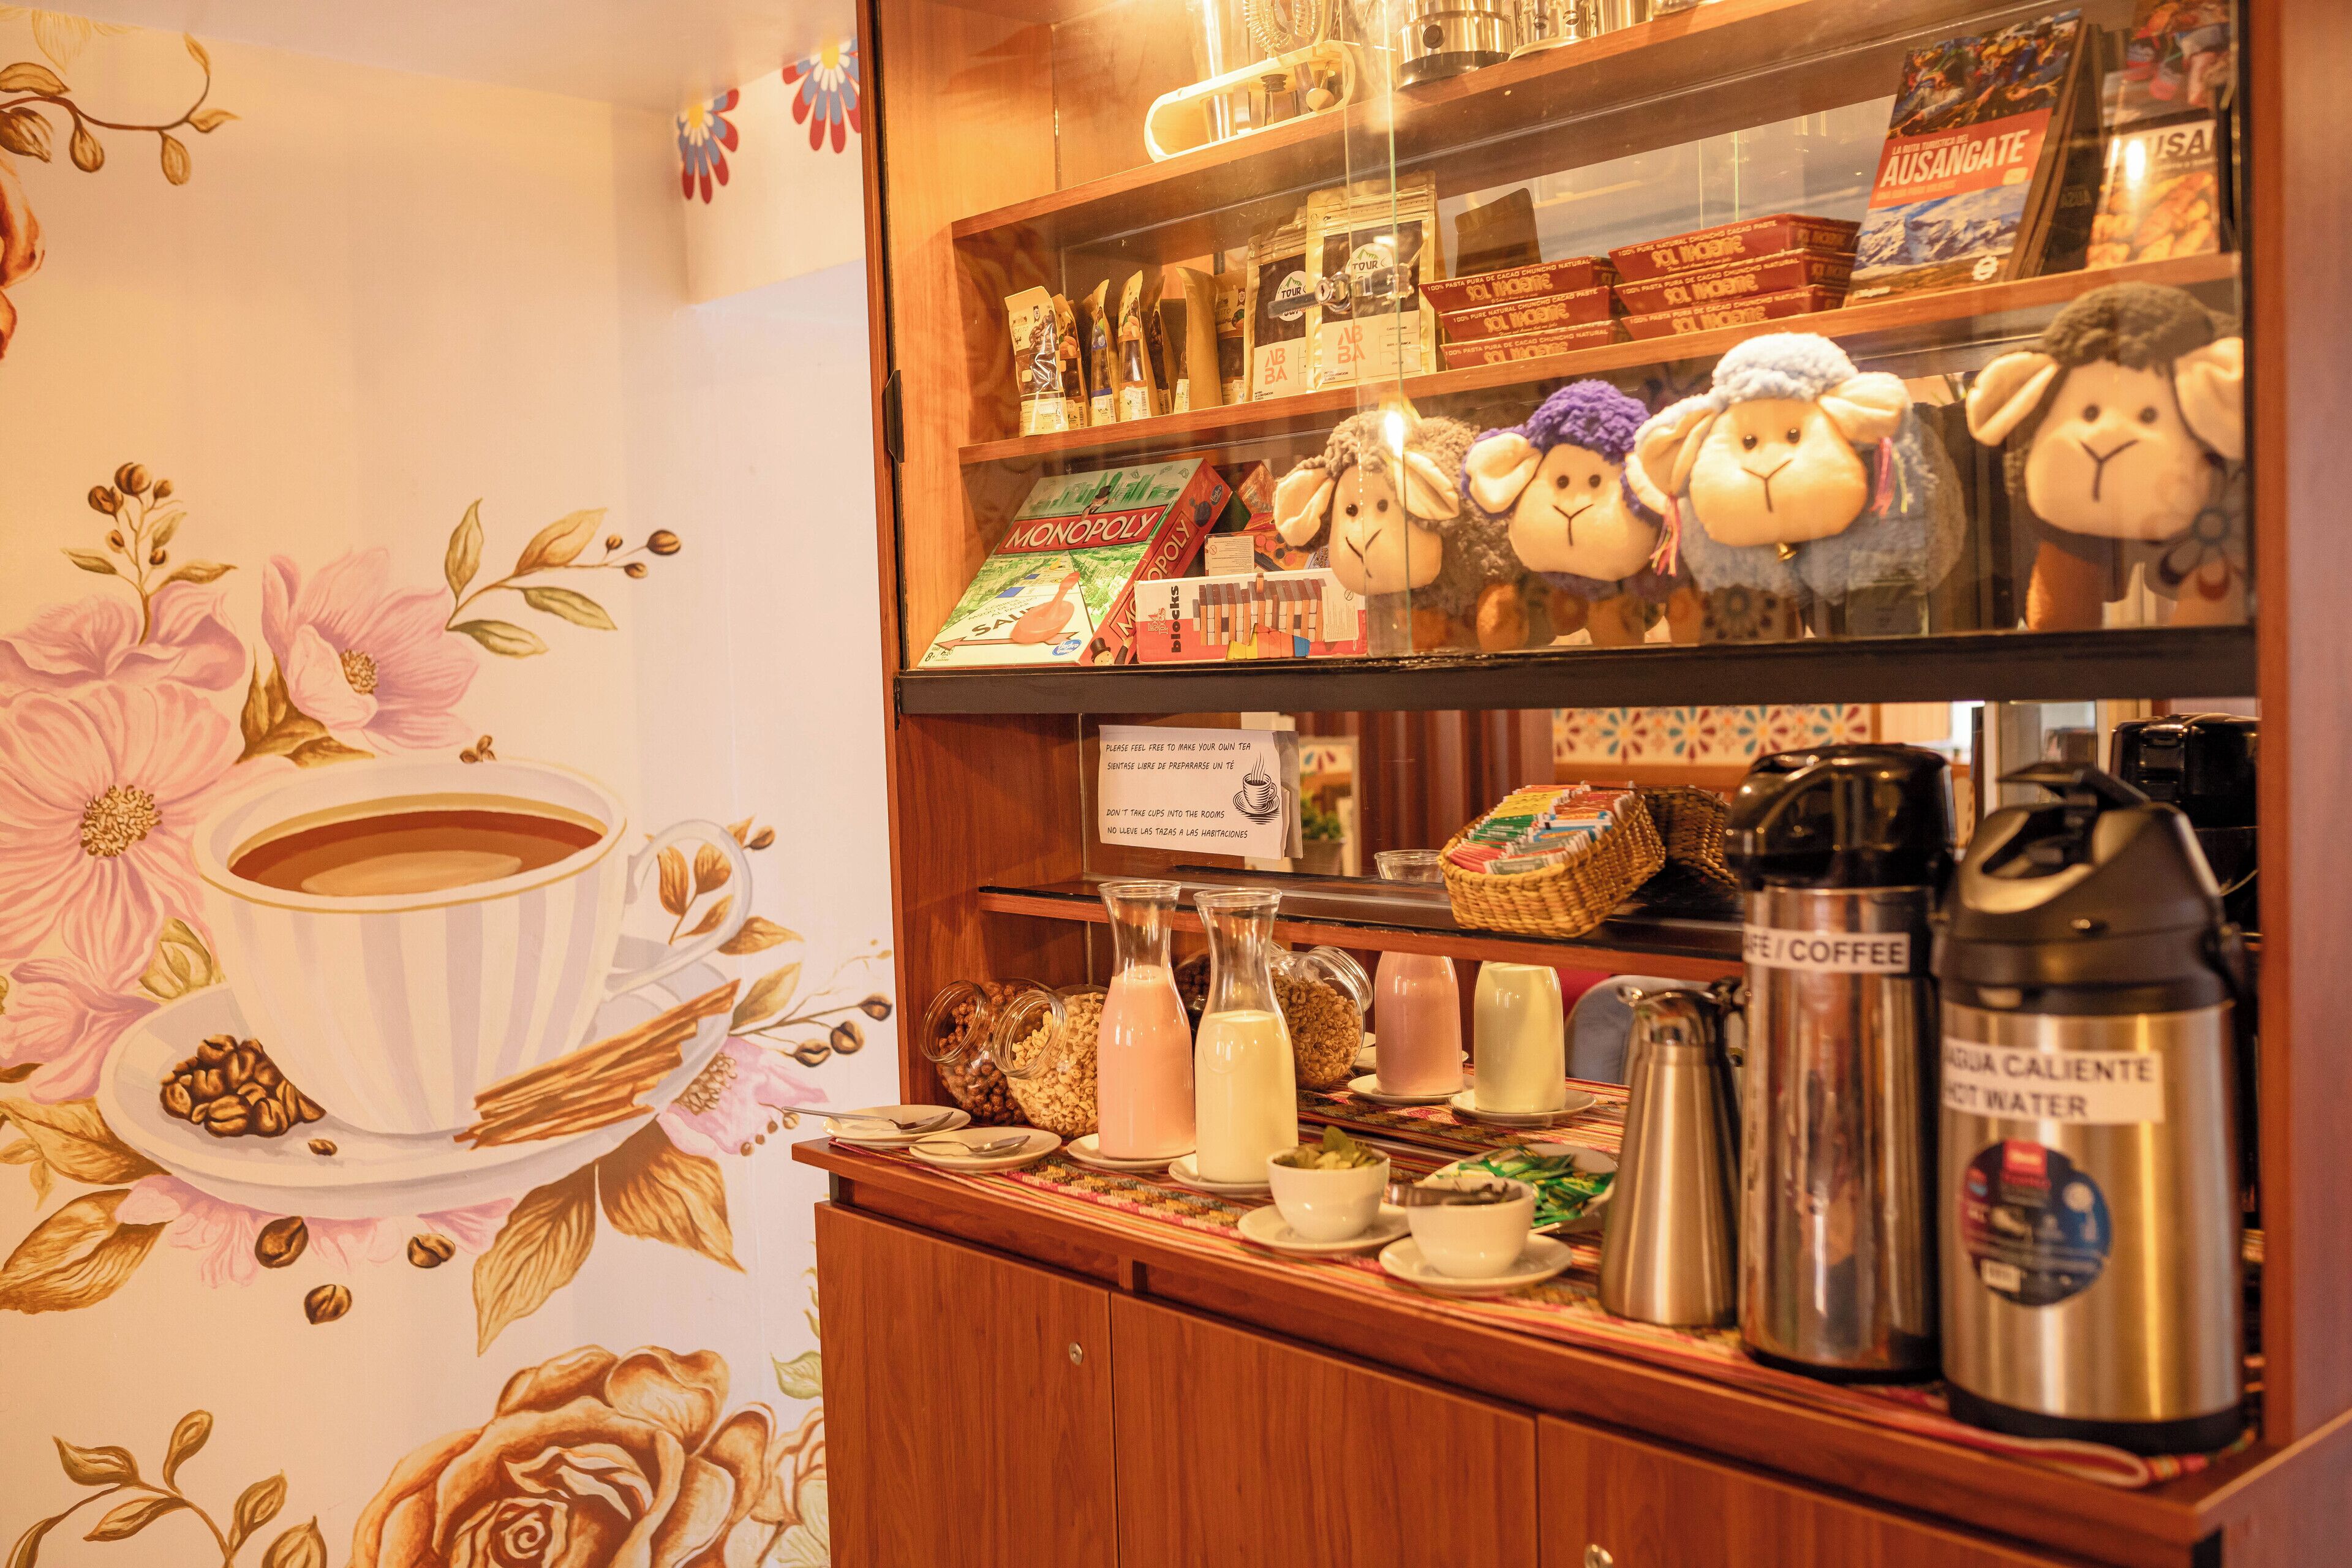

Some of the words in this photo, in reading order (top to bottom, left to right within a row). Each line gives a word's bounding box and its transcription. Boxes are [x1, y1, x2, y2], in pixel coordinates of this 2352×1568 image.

[1879, 129, 2030, 187] AUSANGATE
[1352, 260, 1378, 271] TOUR
[1428, 283, 1444, 292] 100%
[1446, 280, 1465, 288] PASTA
[1497, 270, 1520, 280] CACAO
[1521, 265, 1556, 276] CHUNCHO
[1558, 258, 1591, 270] NATURAL
[1686, 275, 1697, 284] DE
[1281, 287, 1302, 299] TOUR
[1466, 284, 1491, 301] SOL
[1470, 311, 1487, 320] PURE
[1488, 306, 1517, 316] NATURAL
[1518, 298, 1551, 310] CHUNCHO
[1552, 293, 1575, 303] CACAO
[1576, 288, 1597, 299] PASTE
[1694, 306, 1705, 315] DE
[1483, 315, 1509, 333] SOL
[1463, 345, 1482, 354] PASTA
[1484, 342, 1501, 351] PURA
[1515, 337, 1537, 346] CACAO
[1539, 333, 1574, 344] CHUNCHO
[1576, 328, 1608, 339] NATURAL
[1004, 511, 1158, 549] MONOPOLY
[1117, 519, 1191, 636] MOOPOLY
[1147, 614, 1159, 631] 54
[1170, 584, 1182, 653] blocks
[924, 652, 935, 662] 8+
[1106, 744, 1129, 752] PLEASE
[1177, 743, 1196, 752] MAKE
[1199, 743, 1215, 752] YOUR
[1218, 742, 1235, 751] OWN
[1107, 761, 1135, 770] SIENTASE
[1137, 761, 1155, 770] LIBRE
[1157, 761, 1166, 770] DE
[1168, 761, 1210, 770] PREPARARSE
[1213, 761, 1223, 770] UN
[1226, 760, 1235, 770] TÉ
[1201, 810, 1225, 819] ROOMS
[1155, 827, 1177, 836] TAZAS
[1186, 828, 1199, 837] LAS
[1201, 829, 1248, 839] HABITACIONES
[1788, 939, 1904, 966] COFFEE
[2002, 1054, 2153, 1083] CALIENTE
[1985, 1088, 2089, 1117] WATER
